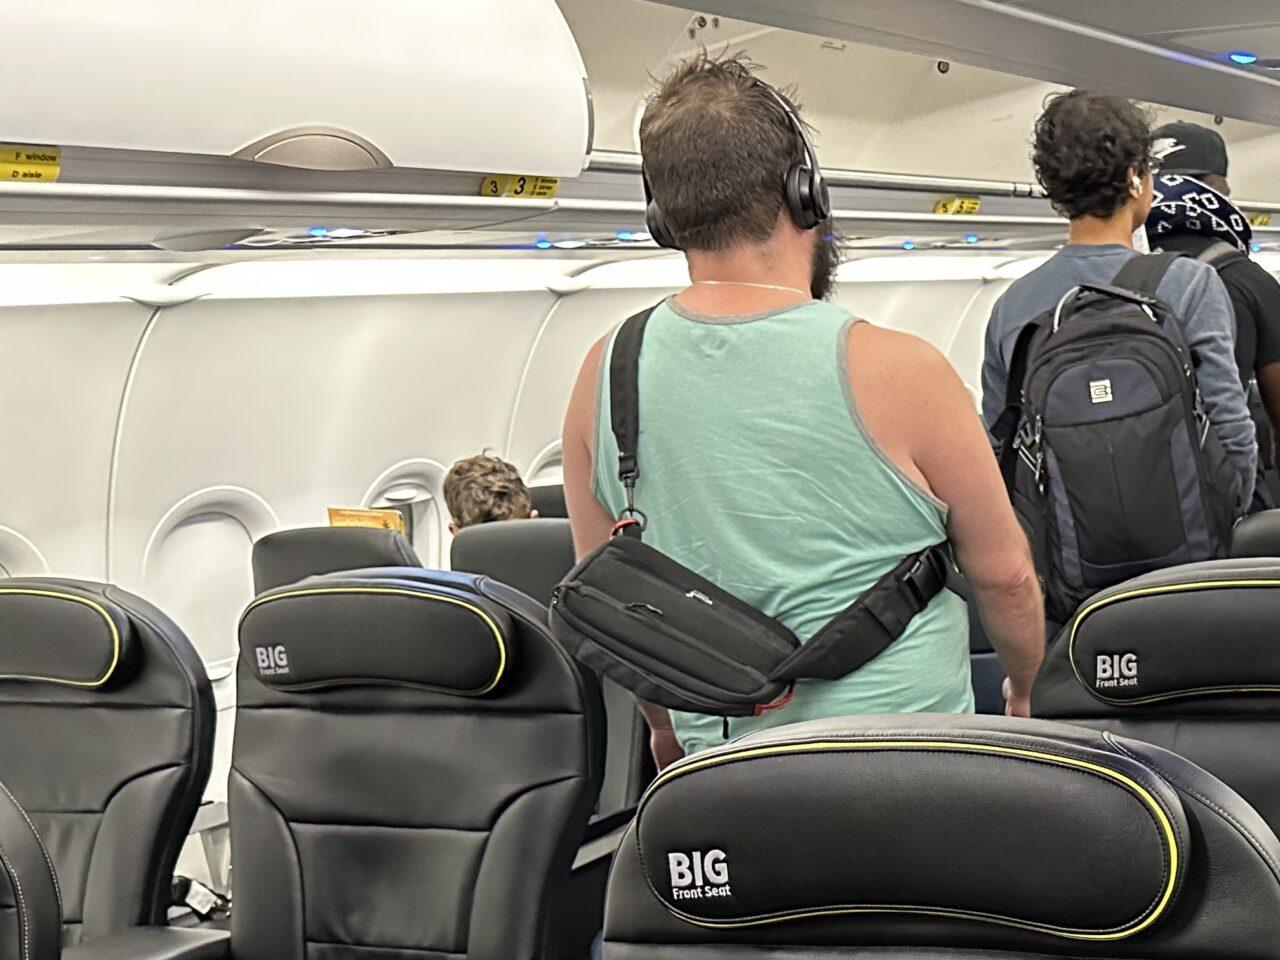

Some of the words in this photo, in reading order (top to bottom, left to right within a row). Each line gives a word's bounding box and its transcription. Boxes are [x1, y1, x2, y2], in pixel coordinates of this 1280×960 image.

[15, 151, 21, 161] F
[26, 152, 57, 162] window
[11, 169, 19, 178] D
[22, 170, 42, 179] aisle
[490, 180, 498, 194] 3
[513, 175, 527, 195] 3
[255, 644, 288, 668] BIG
[1096, 653, 1138, 679] BIG
[1096, 679, 1118, 688] Front
[1119, 677, 1138, 686] Seat
[668, 848, 729, 888] BIG
[672, 886, 703, 901] Front
[704, 884, 732, 898] Seat
